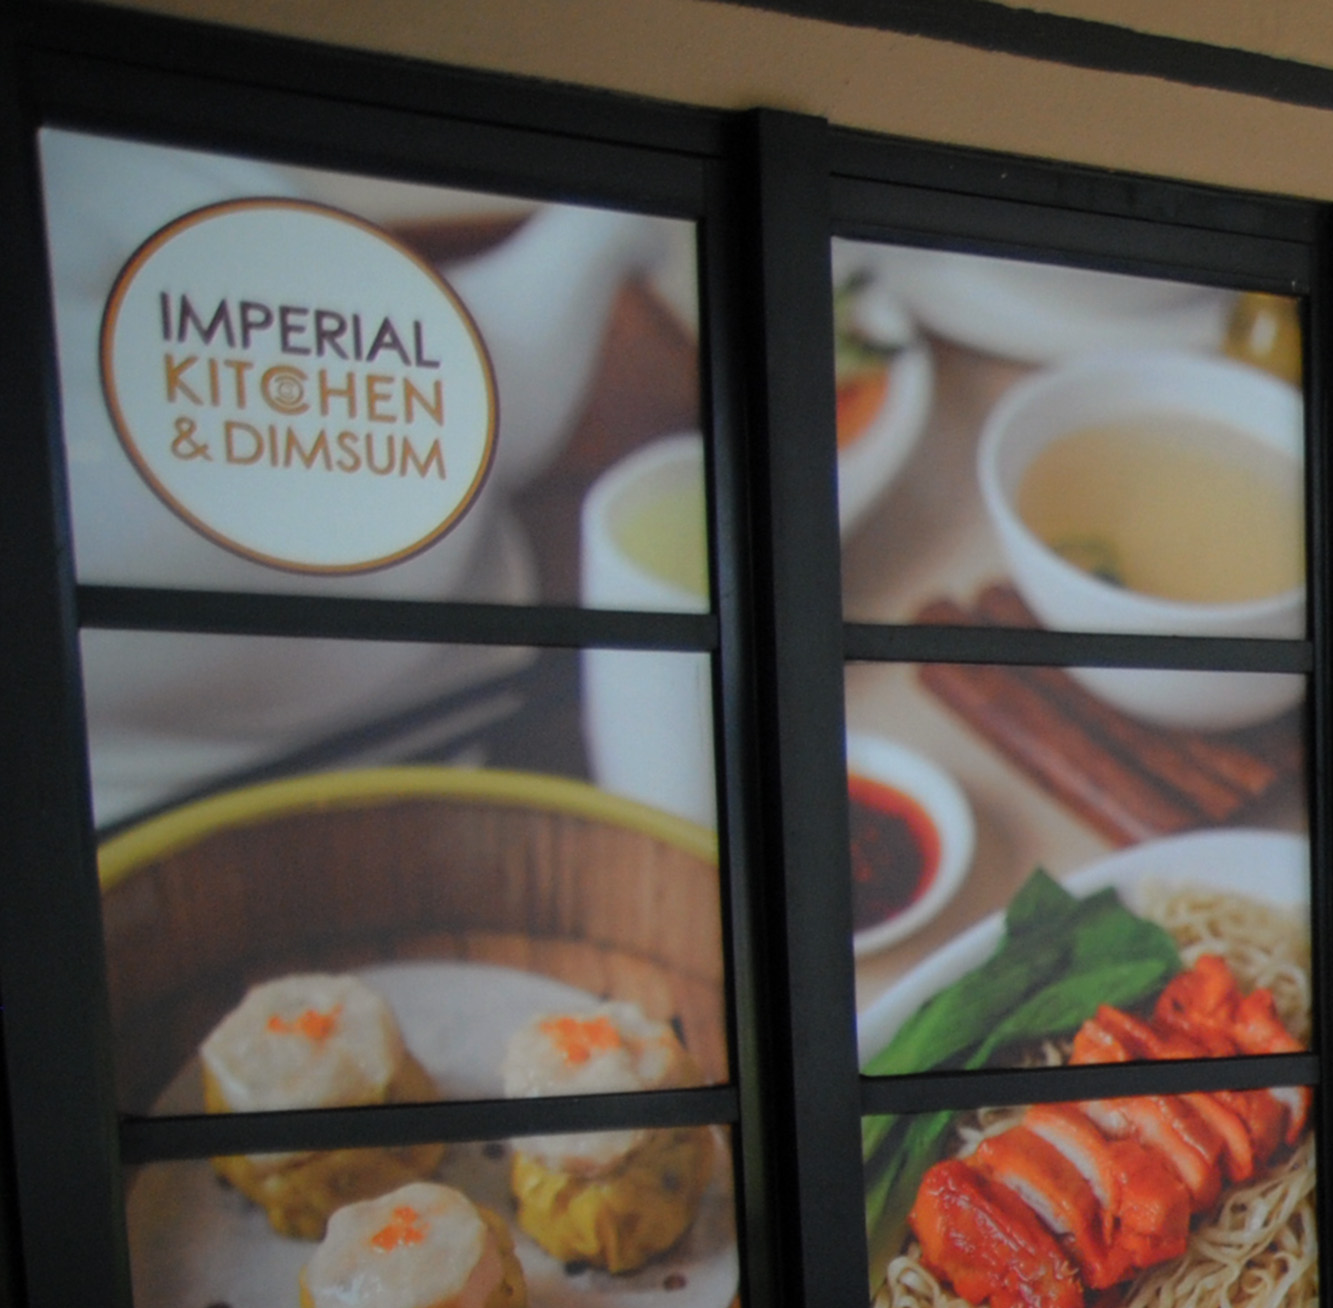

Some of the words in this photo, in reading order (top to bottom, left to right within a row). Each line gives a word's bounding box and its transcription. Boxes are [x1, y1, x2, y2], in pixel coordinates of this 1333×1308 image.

[160, 290, 441, 369] IMPERIAL
[163, 352, 444, 428] KITCHEN
[170, 417, 213, 461] &
[223, 420, 447, 481] DIMSUM
